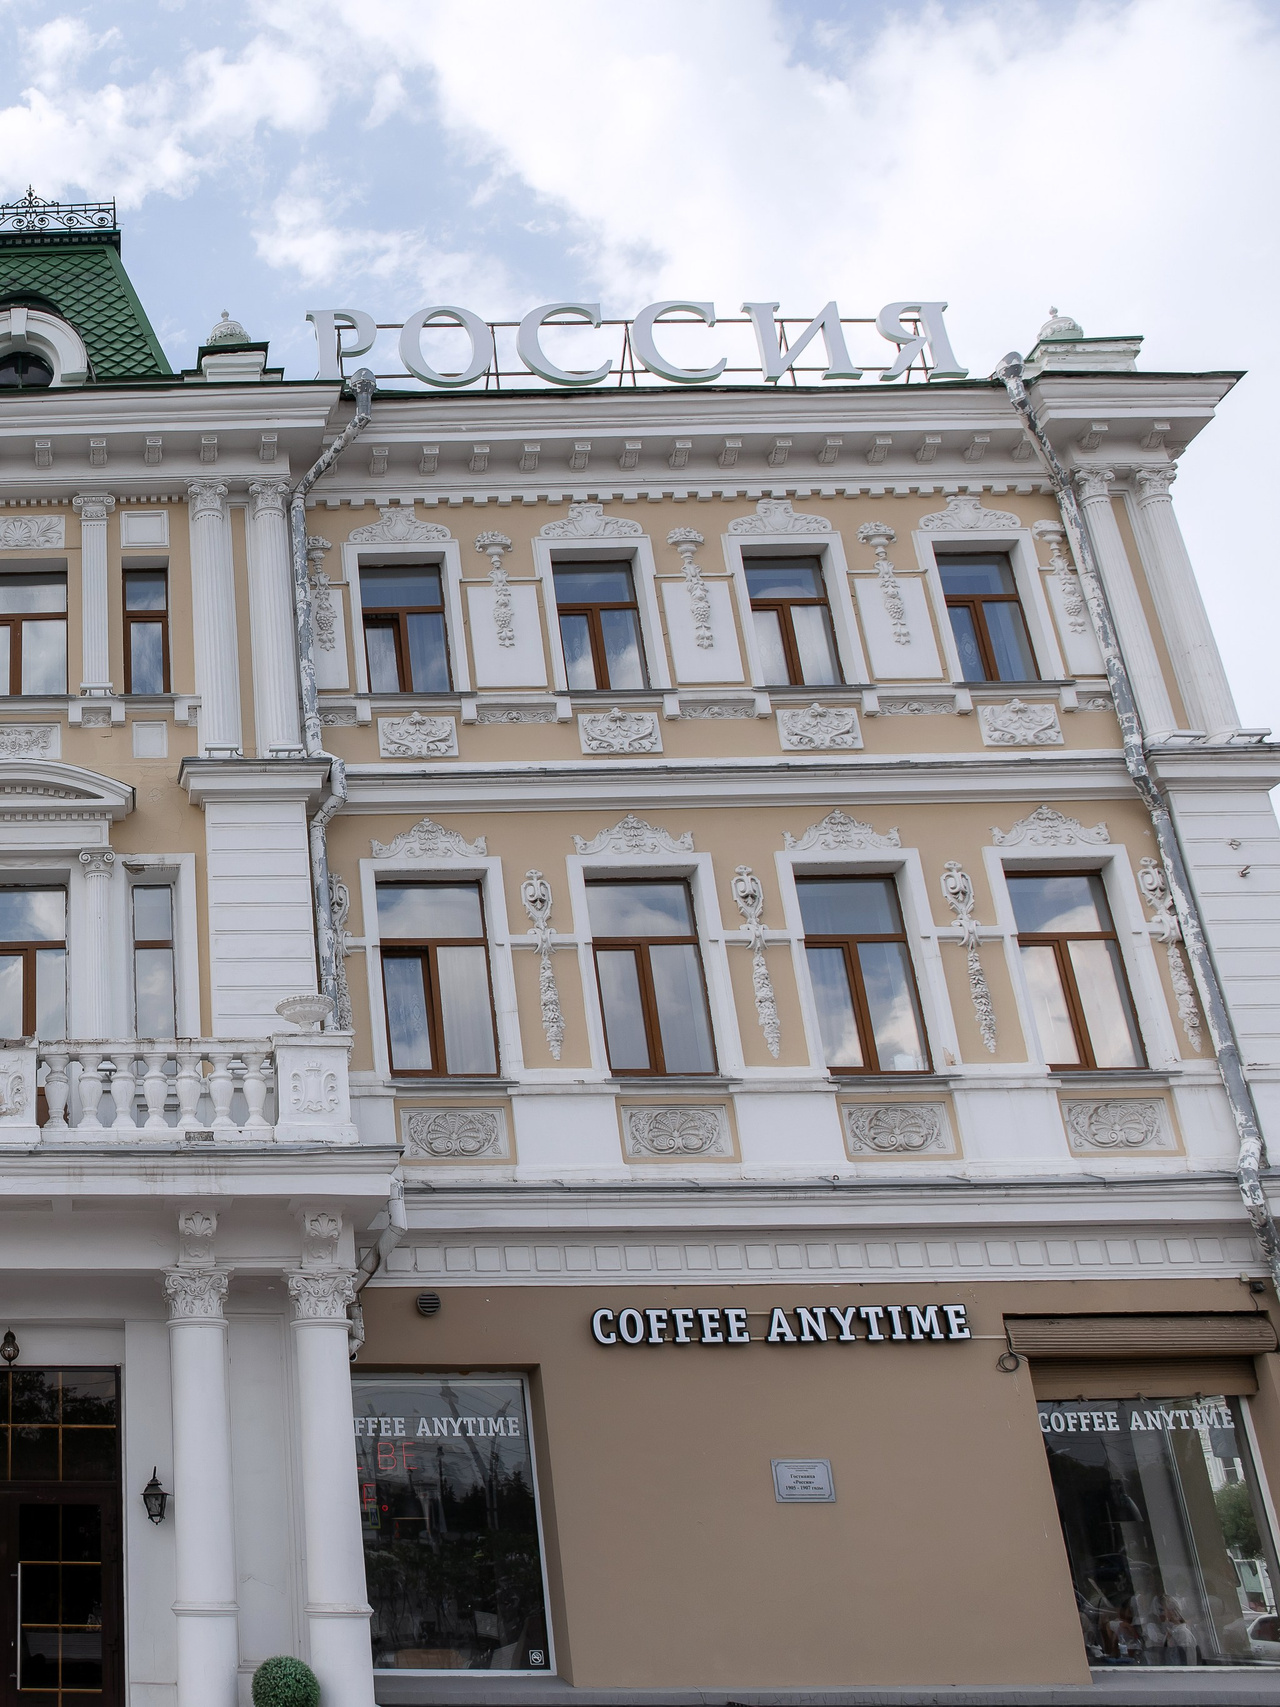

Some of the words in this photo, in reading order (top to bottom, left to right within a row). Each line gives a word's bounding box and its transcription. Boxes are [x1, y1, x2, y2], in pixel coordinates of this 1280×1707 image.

[305, 300, 969, 388] РОССИЯ
[591, 1307, 750, 1346] COFFEE
[765, 1303, 972, 1344] ANYTIME
[354, 1417, 406, 1437] FFEE
[416, 1417, 520, 1437] ANYTIME
[1038, 1411, 1120, 1433] COFFEE
[1130, 1408, 1235, 1431] ANYTIME
